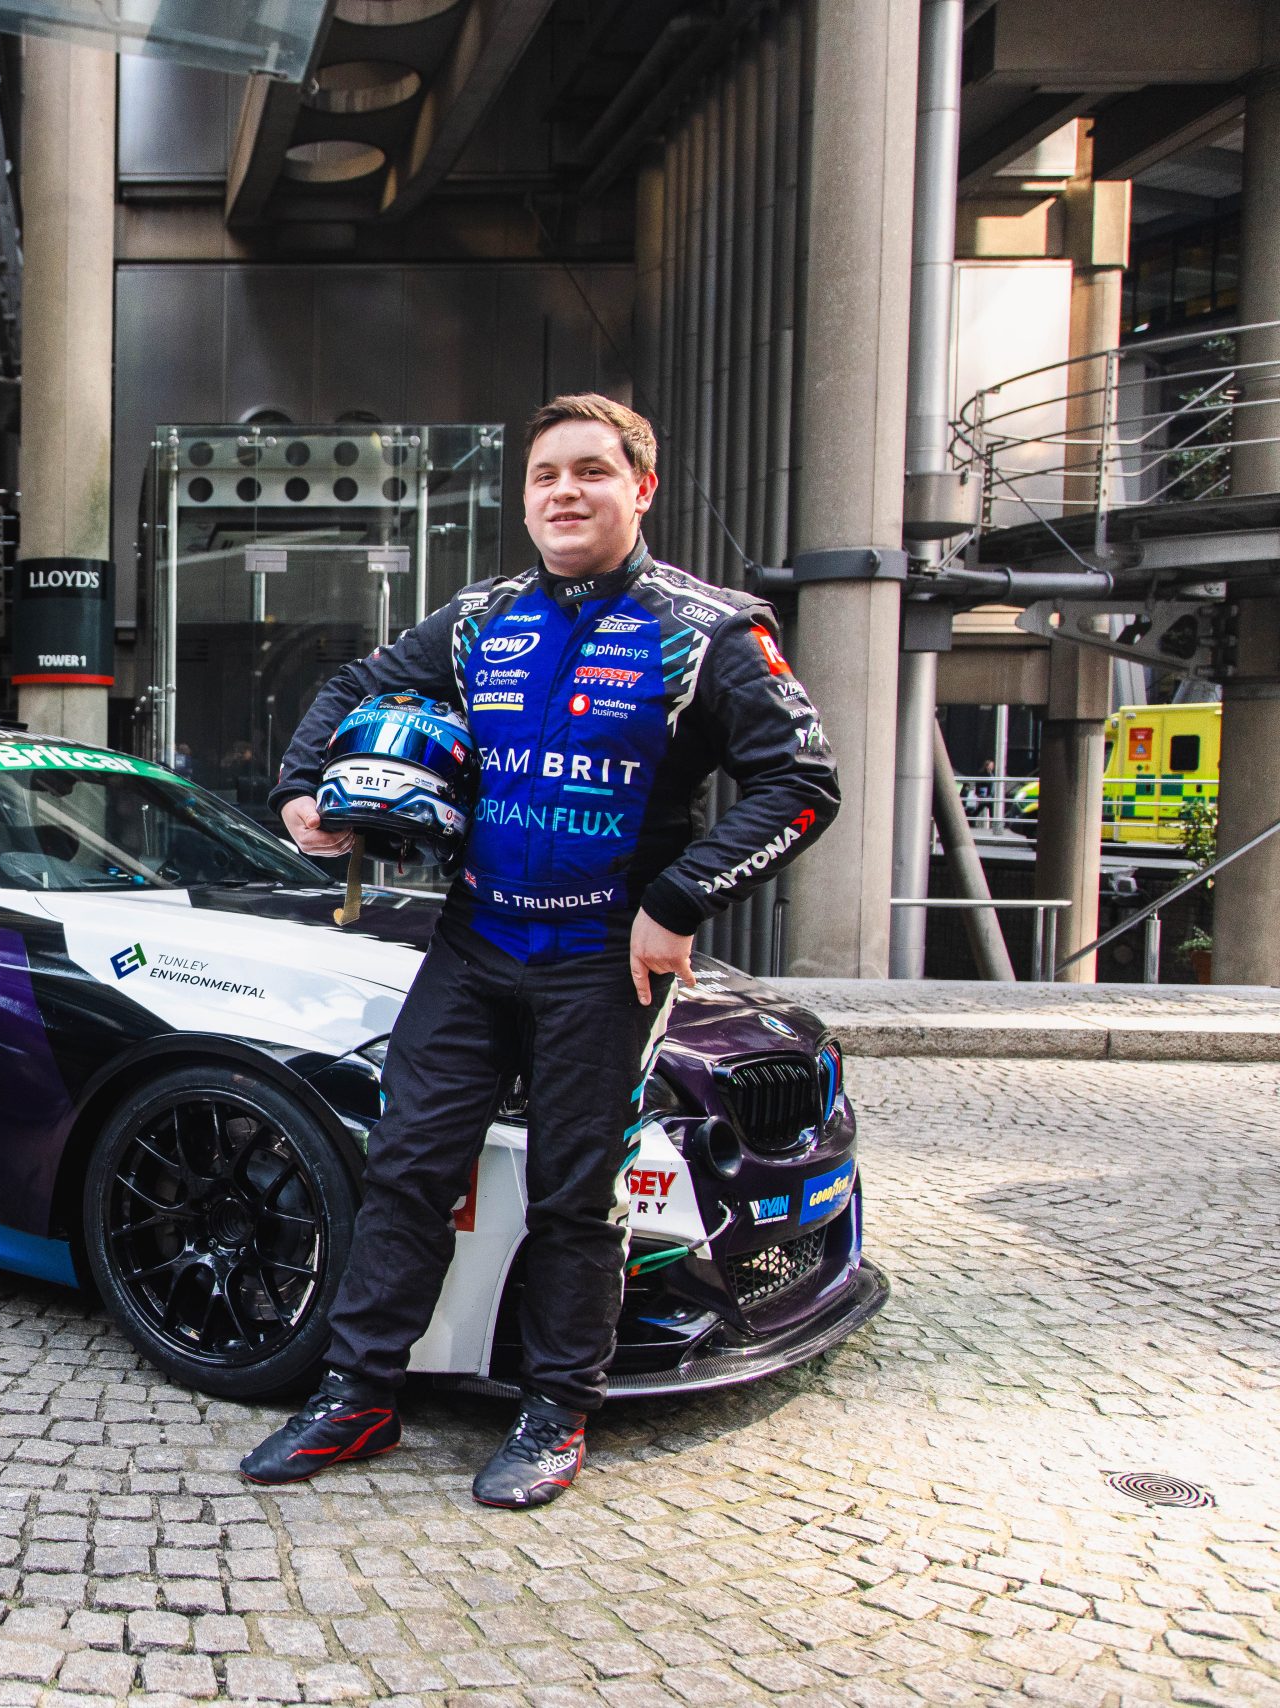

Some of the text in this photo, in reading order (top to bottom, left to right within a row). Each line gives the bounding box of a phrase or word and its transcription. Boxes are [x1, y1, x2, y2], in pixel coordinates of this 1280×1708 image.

[565, 580, 595, 597] BRIT
[682, 604, 717, 623] OMP
[598, 619, 642, 632] Britcar
[481, 637, 529, 653] CDW
[595, 643, 649, 661] phinsys
[38, 655, 87, 667] TOWER 1
[488, 677, 518, 686] Scheme
[490, 669, 530, 680] Motability
[573, 677, 635, 689] BATTERY
[575, 666, 644, 683] ODYSSEY
[591, 706, 628, 719] business
[594, 698, 637, 711] vodafone
[452, 744, 467, 762] RS
[478, 747, 641, 785] EAM BRIT
[355, 776, 391, 788] BRIT
[474, 798, 625, 838] DRIANFLUX
[493, 888, 614, 910] B. TRUNDLEY
[157, 954, 209, 972] TUNLEY
[149, 968, 266, 1000] ENVIRONMENTAL
[538, 1448, 577, 1475] sparco
